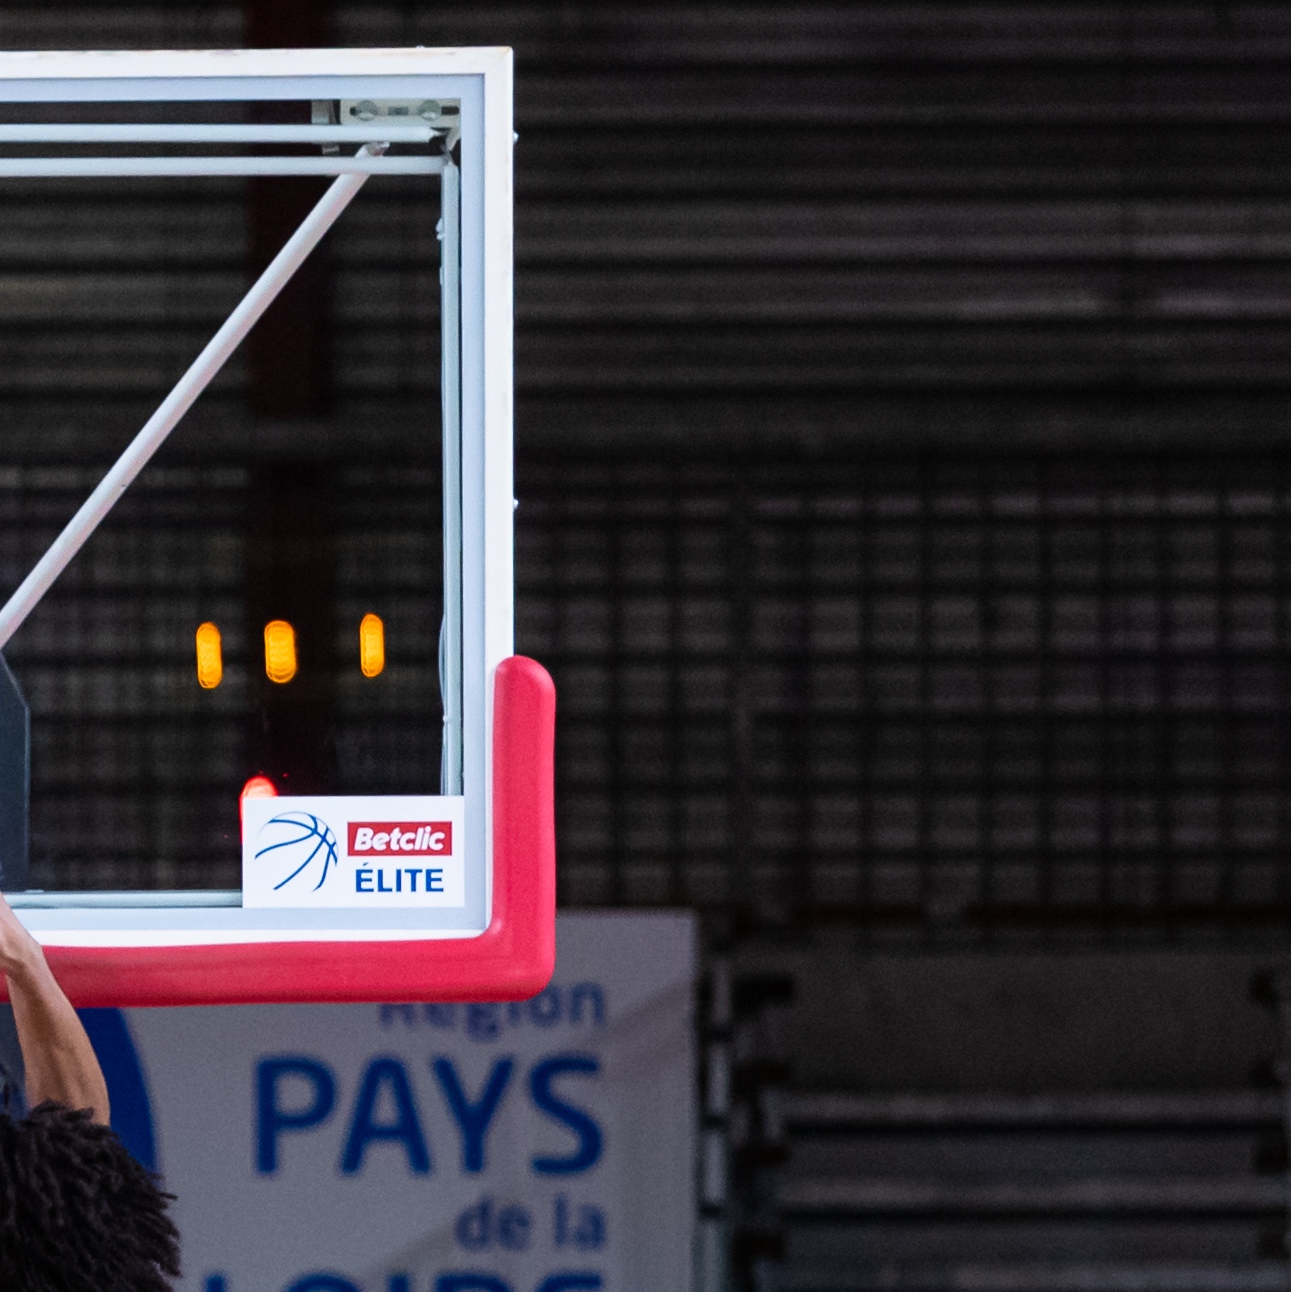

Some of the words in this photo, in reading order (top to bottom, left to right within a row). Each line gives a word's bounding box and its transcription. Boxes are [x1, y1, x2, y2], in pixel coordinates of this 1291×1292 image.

[353, 825, 446, 852] Betclic
[354, 861, 445, 893] ÉLITE
[252, 1053, 605, 1179] PAYS
[453, 1197, 531, 1254] de
[554, 1197, 606, 1254] la
